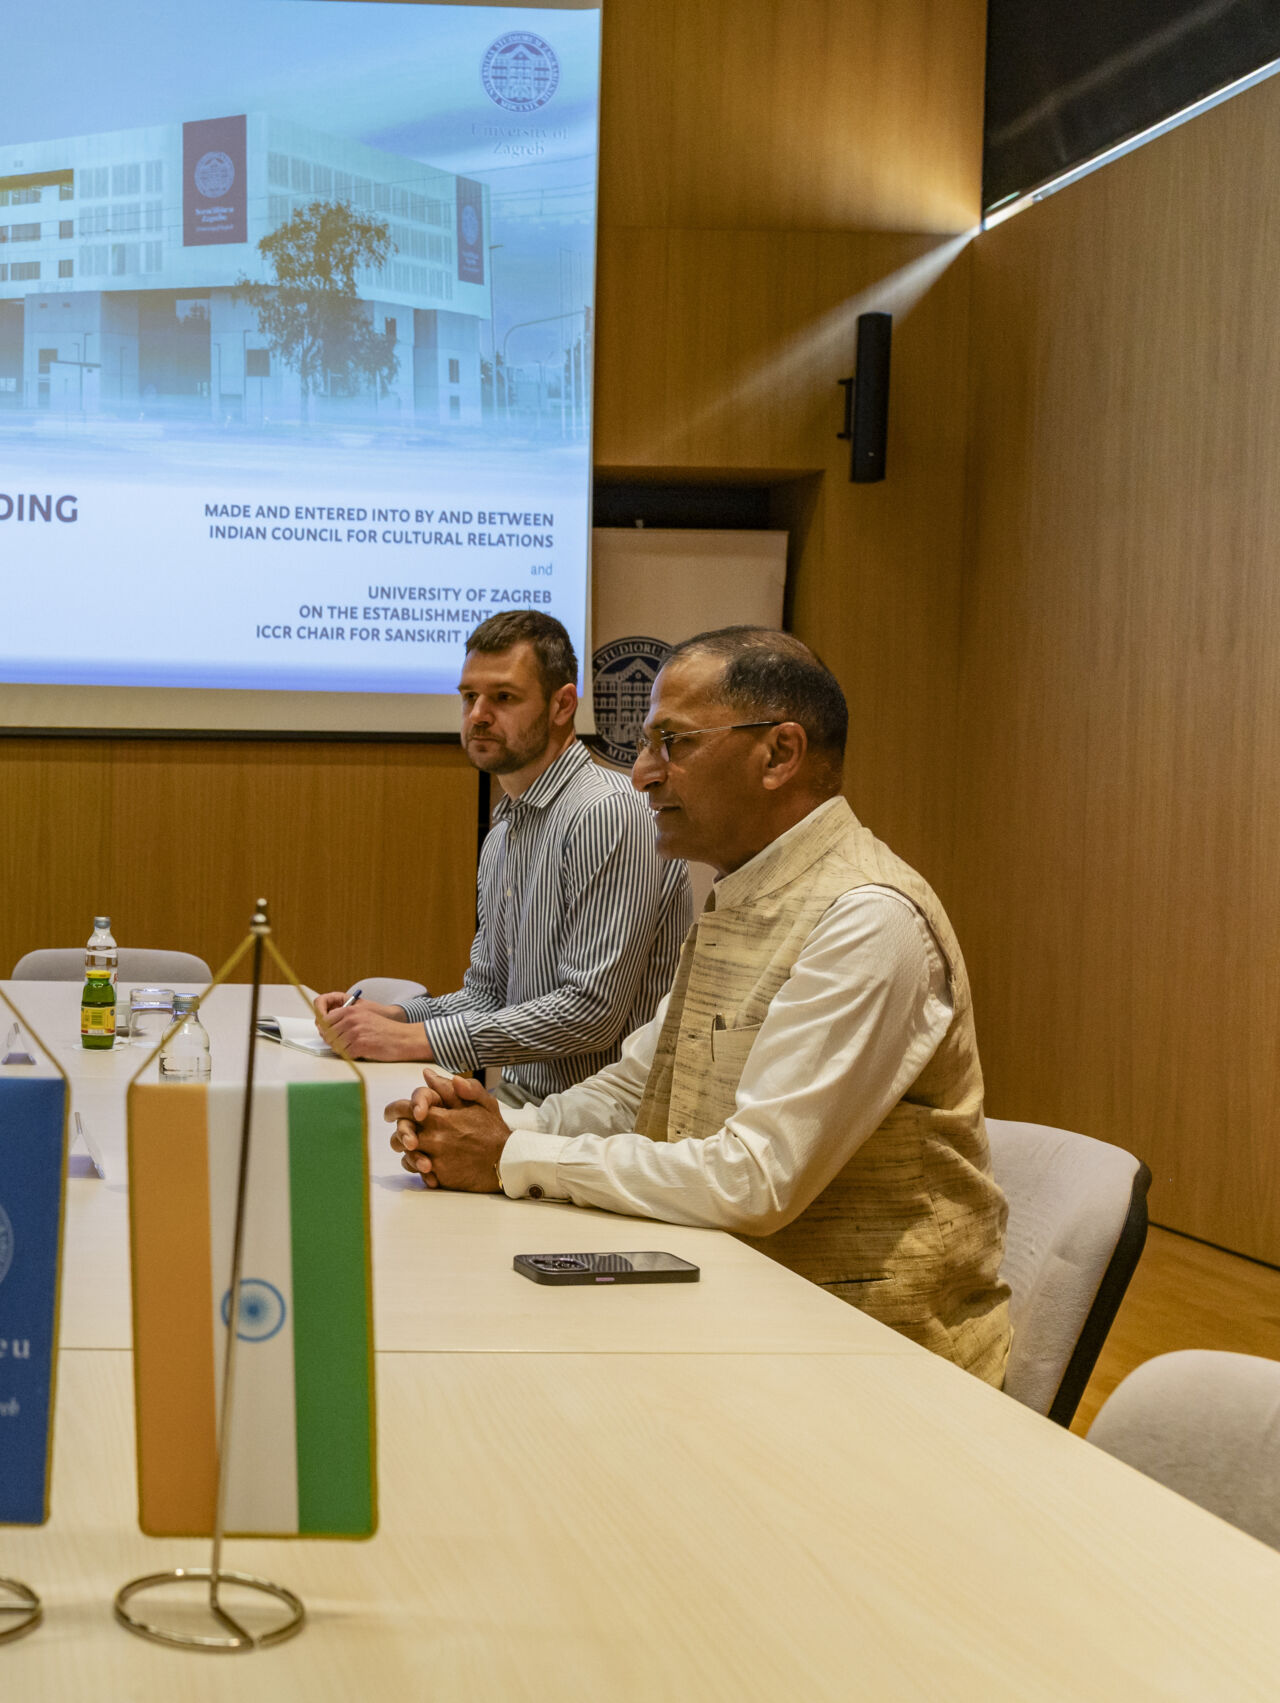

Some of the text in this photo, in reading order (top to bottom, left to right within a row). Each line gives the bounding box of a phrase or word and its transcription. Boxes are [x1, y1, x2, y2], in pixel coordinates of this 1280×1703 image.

[204, 503, 554, 527] MADE AND ENTERED INTO BY AND BETWEEN
[209, 525, 554, 548] INDIAN COUNCIL FOR CULTURAL RELATIONS
[530, 563, 553, 576] and
[367, 585, 552, 604] UNIVERSITY OF ZAGREB
[299, 605, 492, 623] ON THE ESTABLISHMENT
[256, 624, 292, 639] ICCR
[296, 626, 345, 641] CHAIR
[350, 627, 381, 641] FOR
[385, 628, 461, 643] SANSKRIT
[12, 1338, 31, 1360] u
